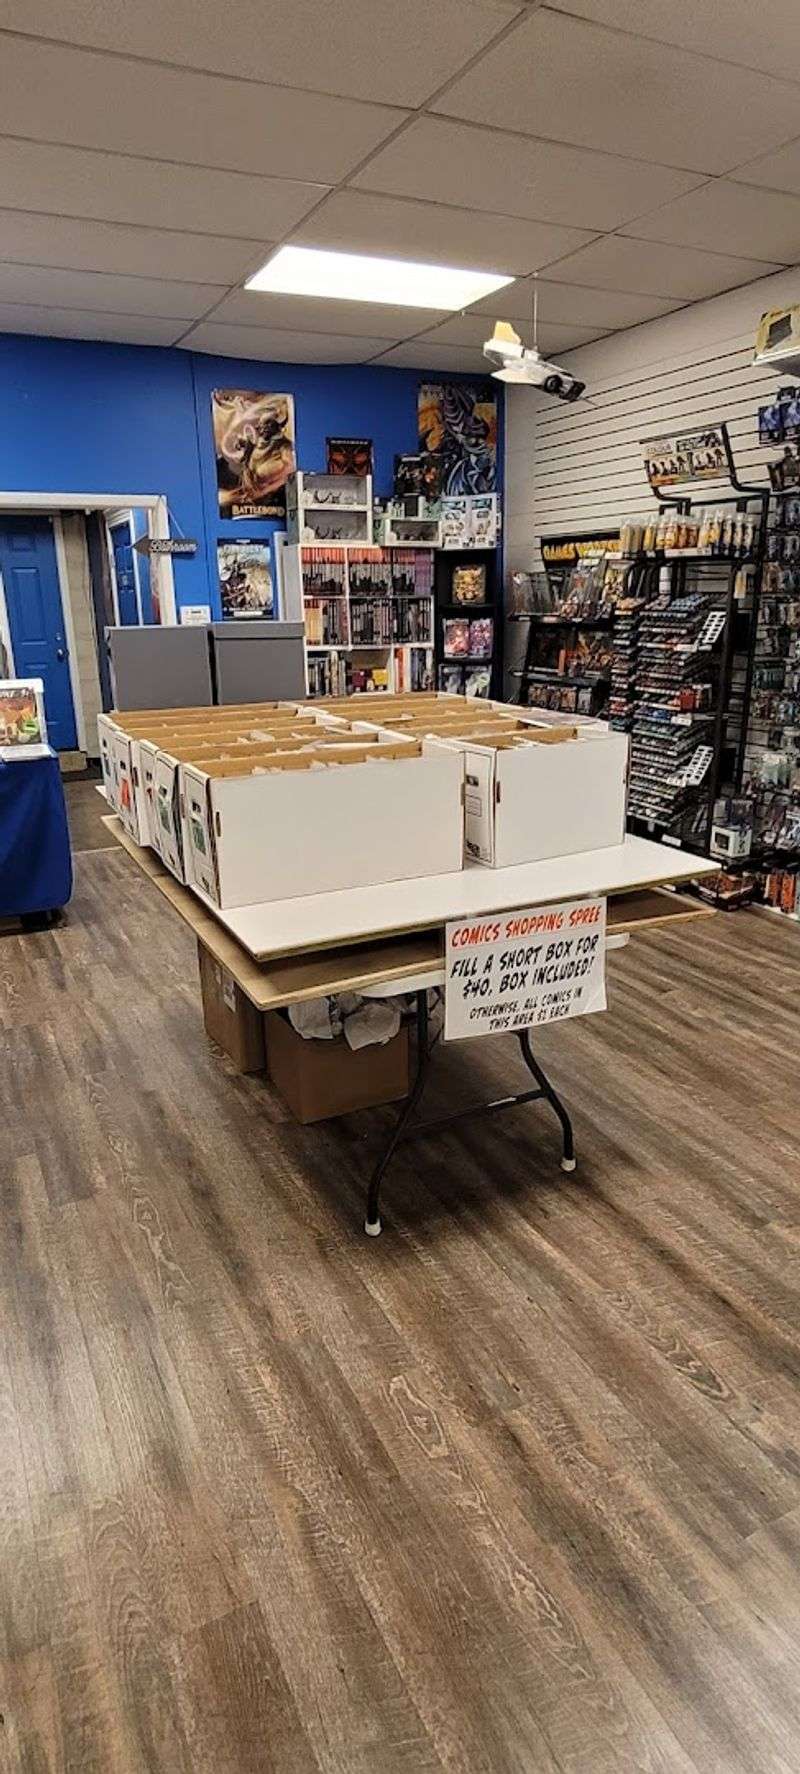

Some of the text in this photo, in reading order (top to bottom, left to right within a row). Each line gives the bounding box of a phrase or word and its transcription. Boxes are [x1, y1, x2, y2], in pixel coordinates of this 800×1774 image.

[232, 504, 285, 517] BATTLEBOND
[149, 539, 198, 553] Bathroom
[543, 542, 577, 560] GAMES
[451, 906, 602, 947] COMICS SHOPPING SPREE
[450, 934, 600, 978] FILL A SHORT BOX FOR
[463, 956, 595, 1000] $40, BOX INCLUDED!
[469, 986, 583, 1020] OTHERWISE, ALL COMICS IN
[489, 1018, 510, 1031] THIS
[512, 1012, 534, 1026] AREA
[550, 1005, 570, 1019] EACH
